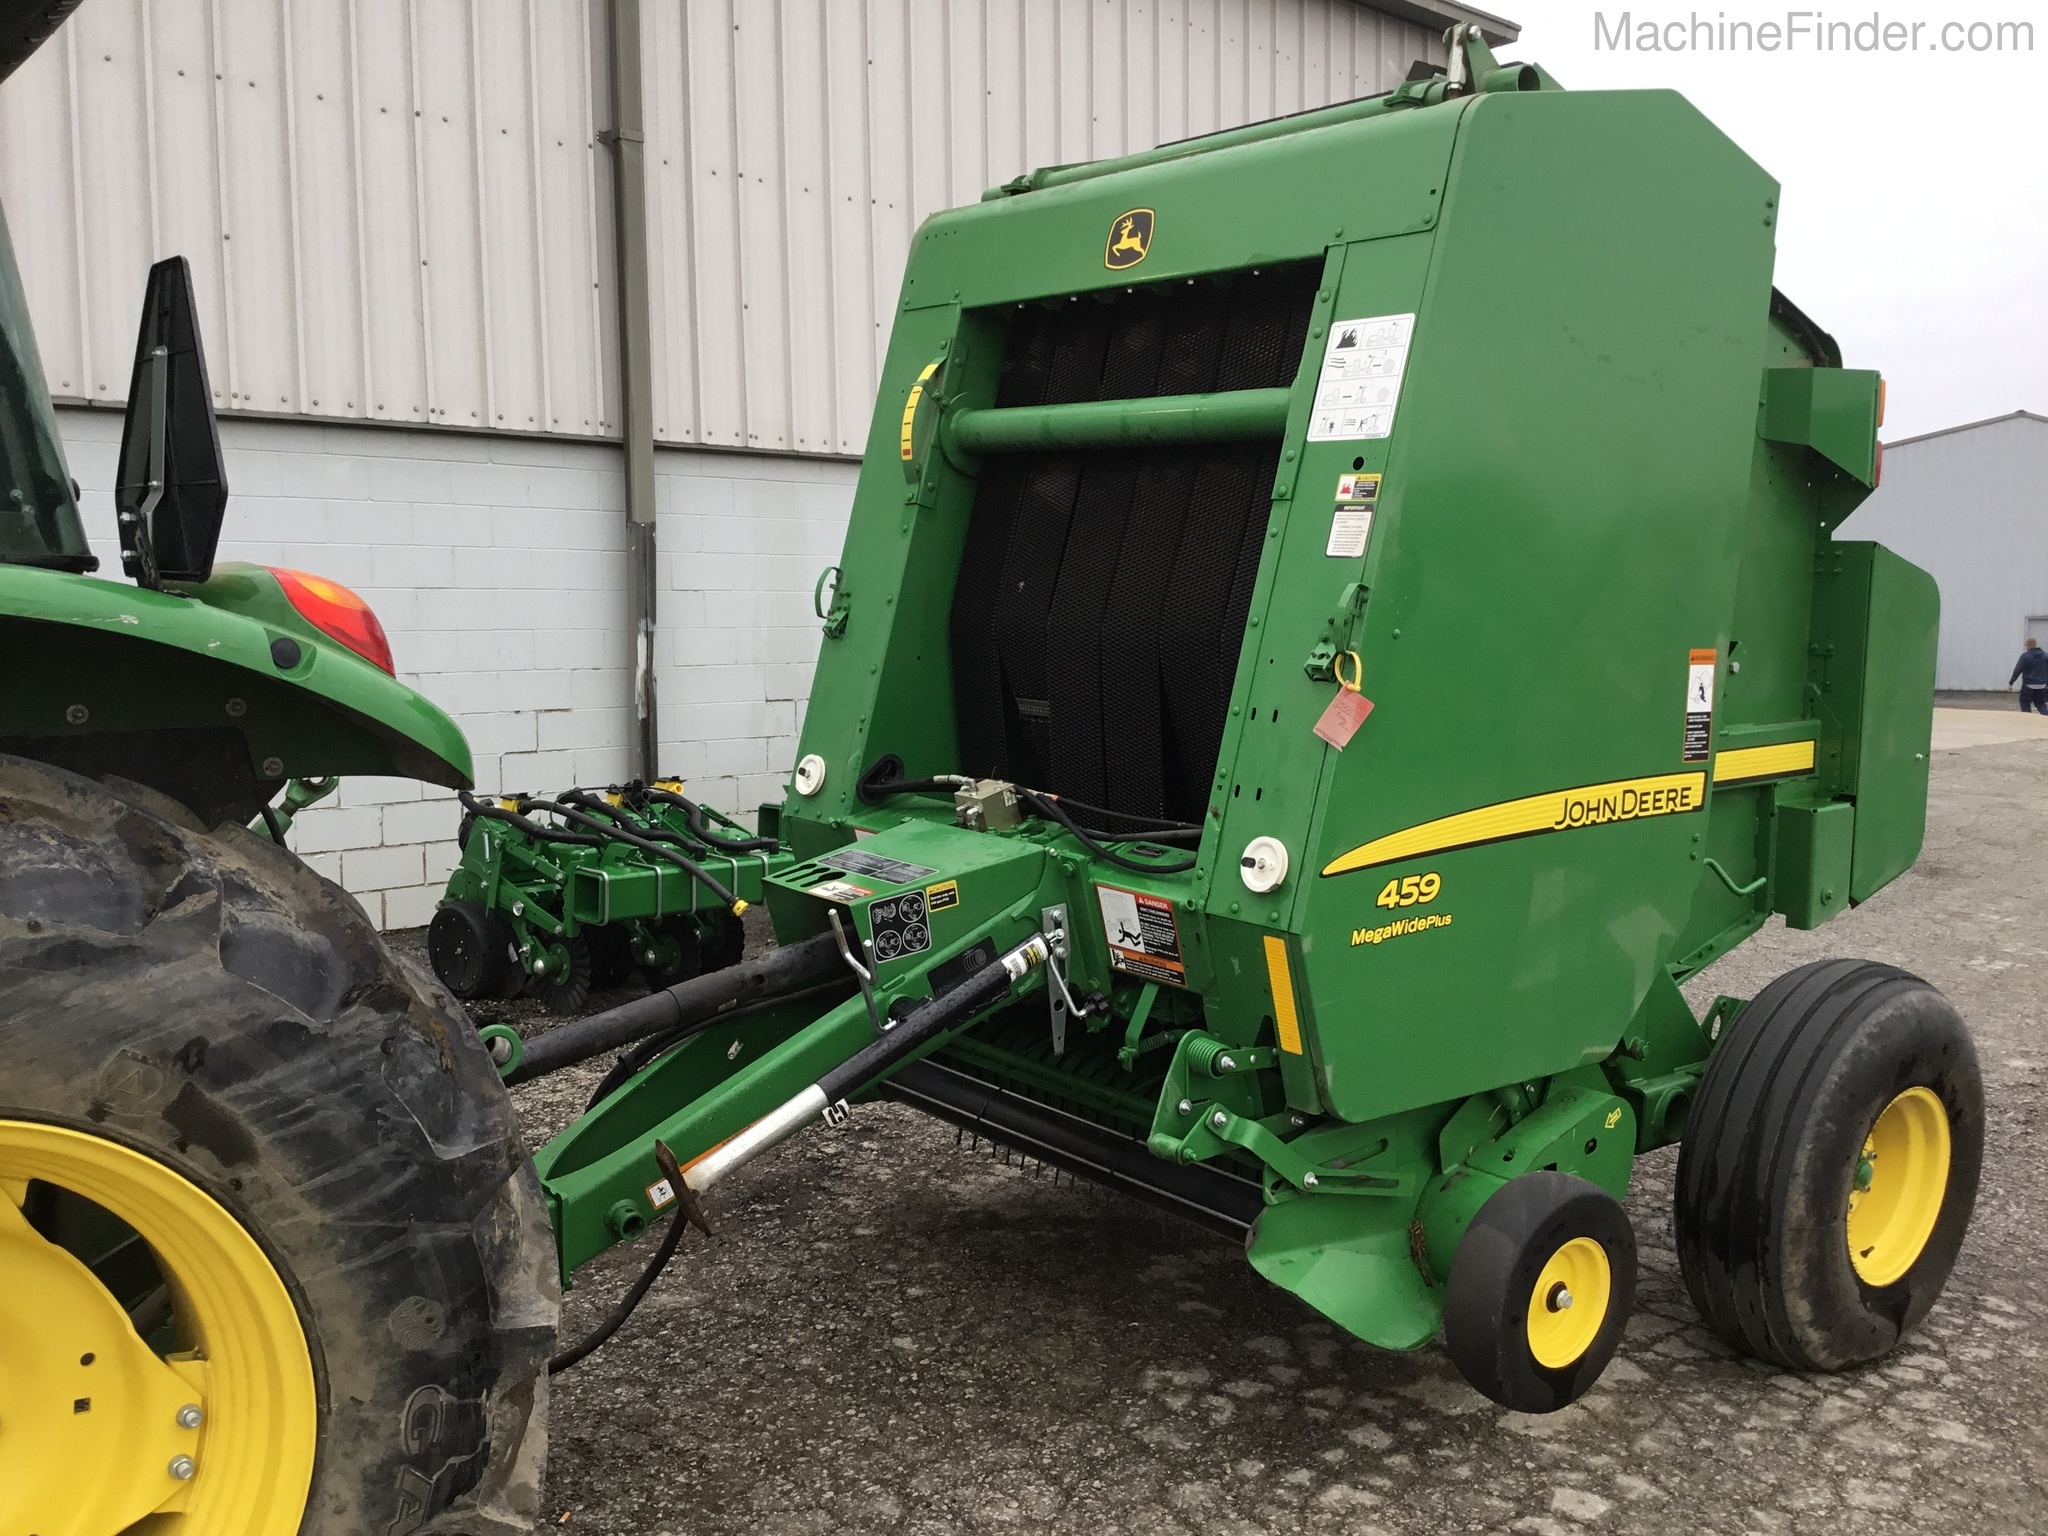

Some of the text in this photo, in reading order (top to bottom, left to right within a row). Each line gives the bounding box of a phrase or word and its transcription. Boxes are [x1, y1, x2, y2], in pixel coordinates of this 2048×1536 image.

[1554, 786, 1692, 826] JOHN DEERE
[1144, 898, 1169, 910] DANGER
[1376, 872, 1442, 909] 459
[1351, 914, 1453, 947] MegaWidePlus
